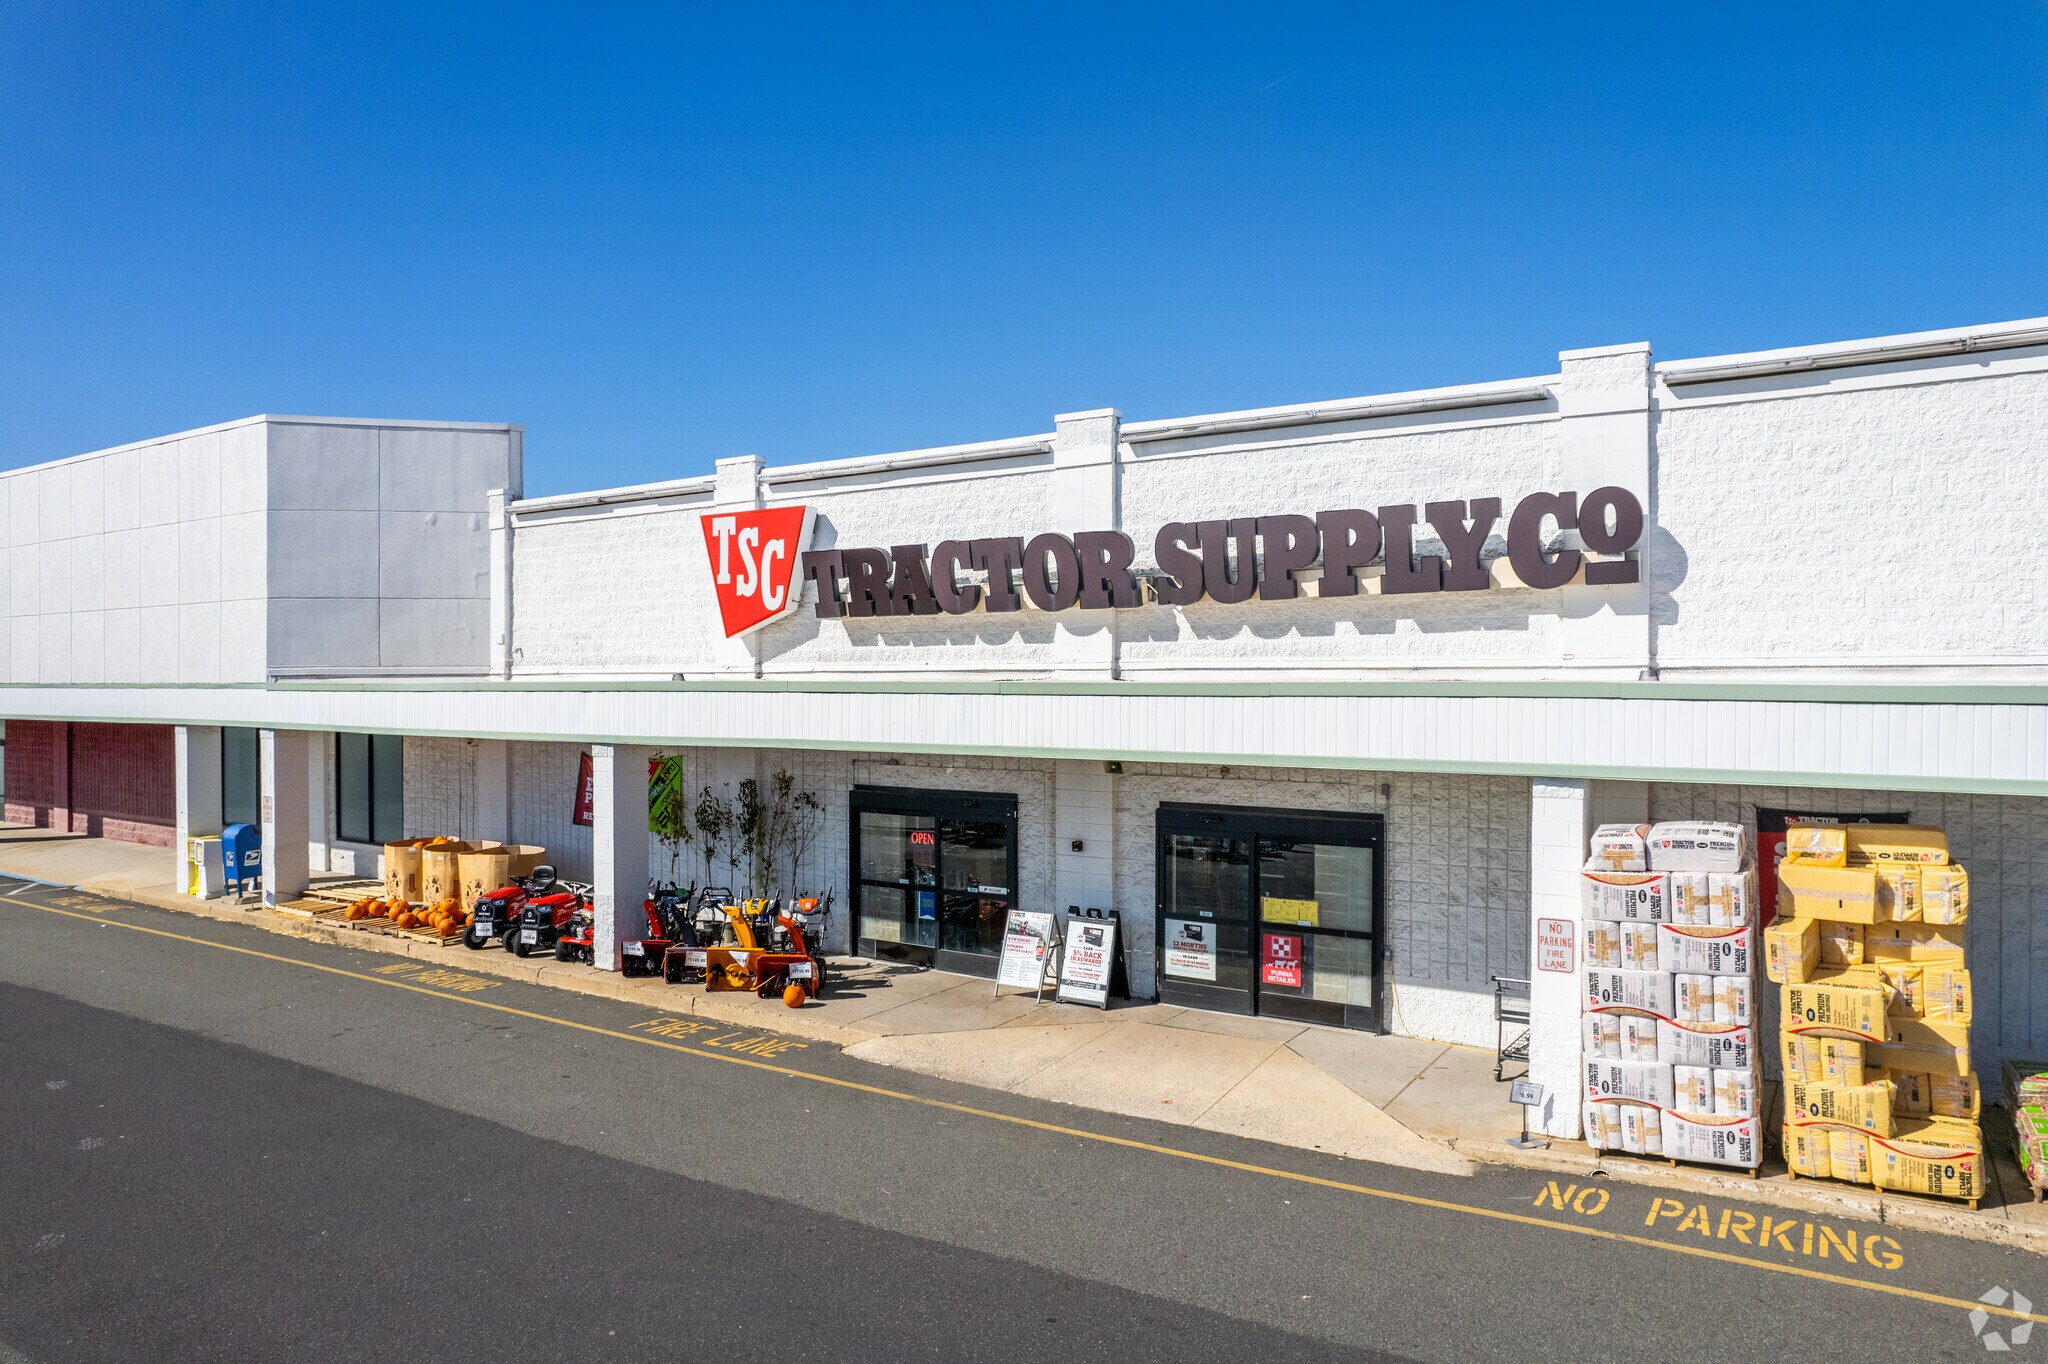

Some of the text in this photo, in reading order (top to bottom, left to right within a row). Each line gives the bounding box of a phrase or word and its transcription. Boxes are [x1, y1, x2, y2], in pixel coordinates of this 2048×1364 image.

[802, 530, 1147, 618] TRACTOR
[1155, 496, 1502, 605] SUPPLY
[712, 515, 785, 611] TSC
[1798, 816, 1839, 824] TRACTOR
[911, 832, 934, 845] OPEN
[1550, 924, 1562, 934] NO
[1540, 936, 1572, 948] PARKING
[1084, 951, 1102, 959] BACK
[1547, 950, 1564, 958] FIRE
[1545, 959, 1567, 968] LANE
[1271, 970, 1293, 978] PURINA
[1268, 976, 1296, 984] RETAILER
[628, 1017, 809, 1058] FIRE LANE
[1934, 1165, 1942, 1194] PREMIUM
[1533, 1180, 1904, 1270] NO PARKING
